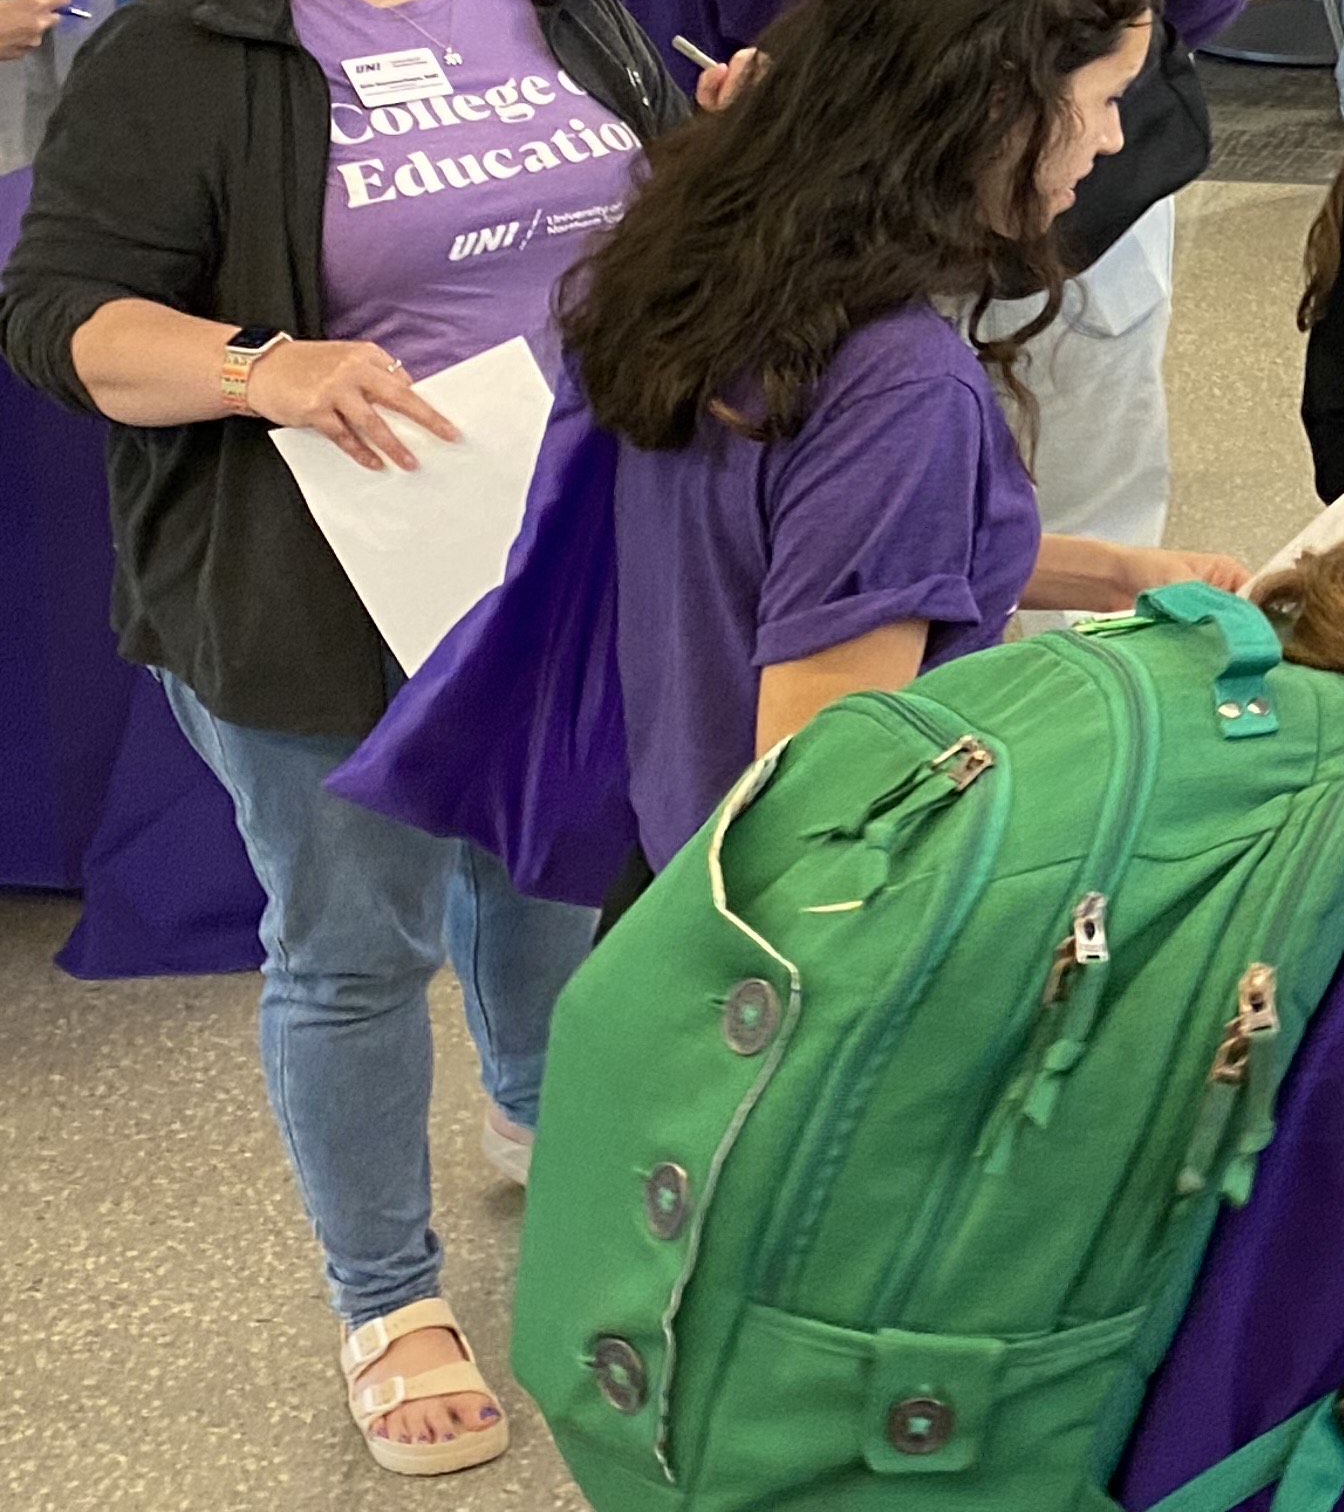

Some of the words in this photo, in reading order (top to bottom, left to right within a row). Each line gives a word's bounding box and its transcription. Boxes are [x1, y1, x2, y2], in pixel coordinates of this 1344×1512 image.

[356, 62, 381, 73] UNI
[330, 74, 556, 145] College
[336, 118, 643, 209] Educatio
[448, 221, 520, 261] UNI
